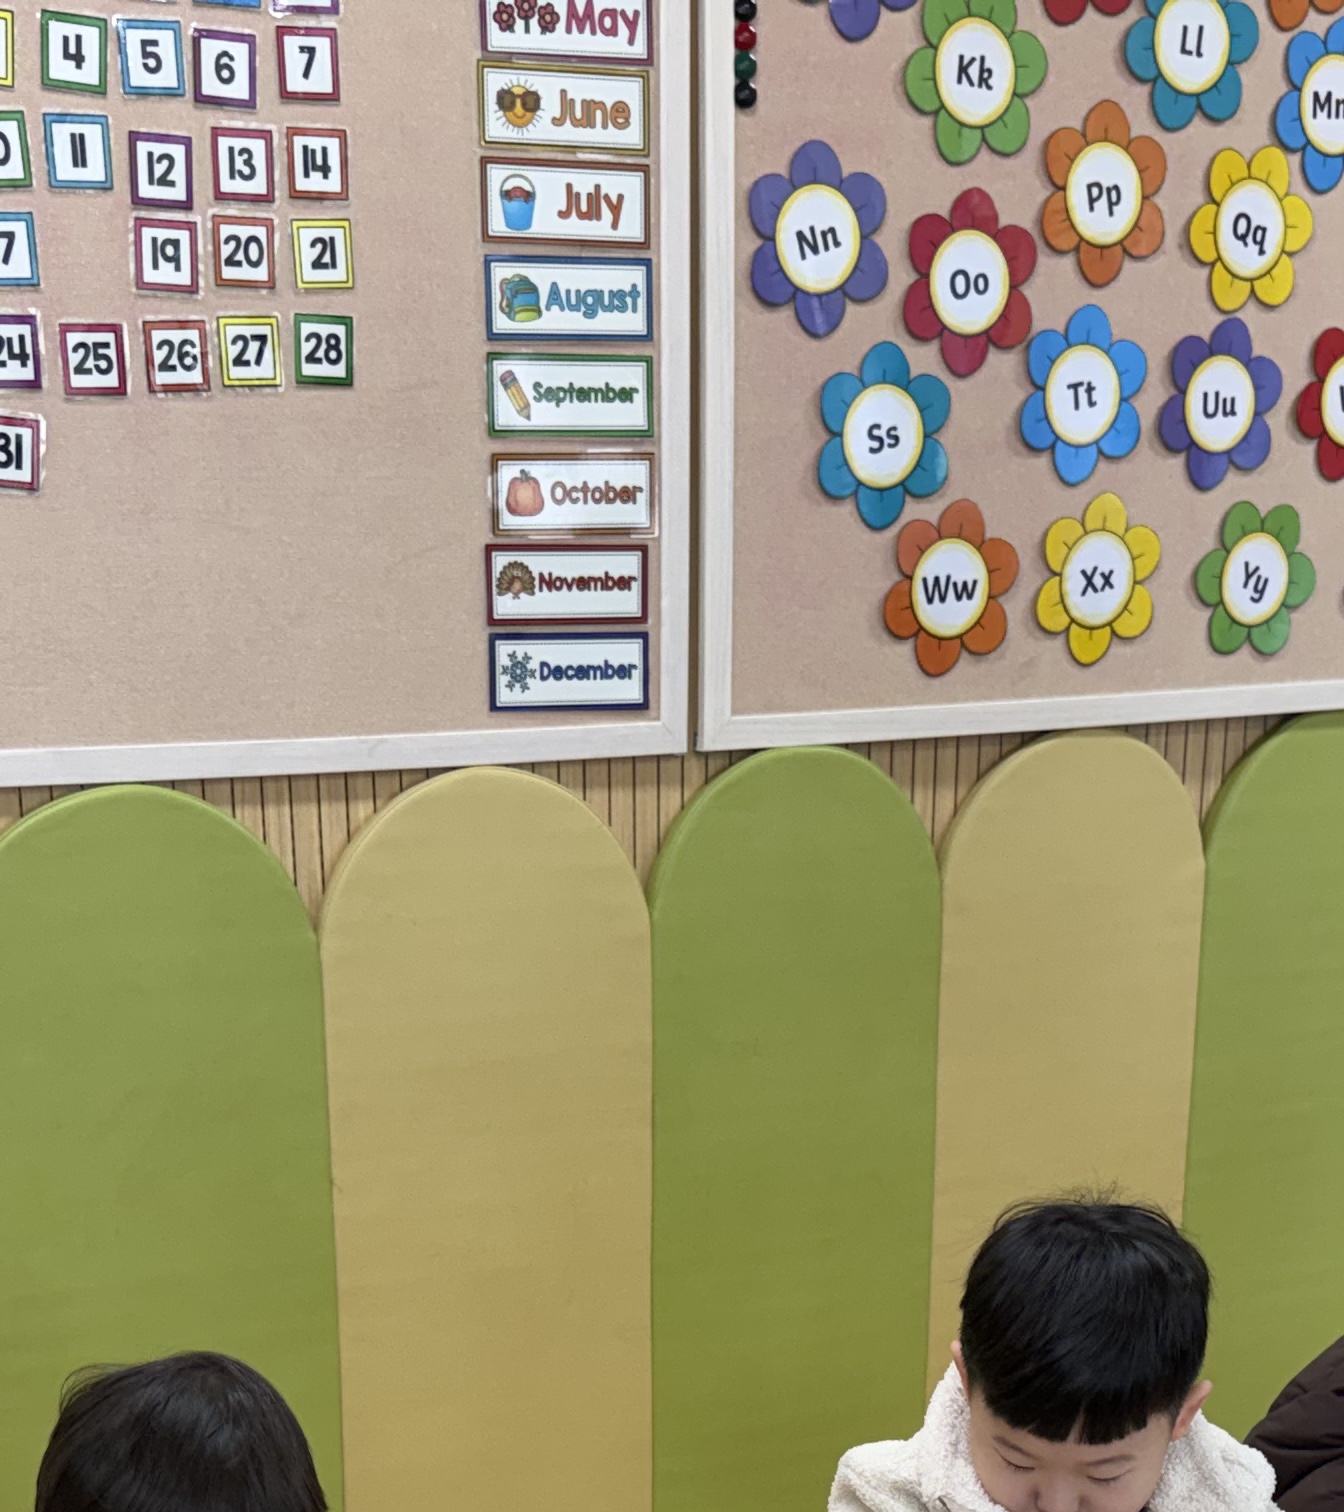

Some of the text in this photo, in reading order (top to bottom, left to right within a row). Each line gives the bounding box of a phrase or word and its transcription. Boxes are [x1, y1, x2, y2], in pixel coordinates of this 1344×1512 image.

[564, 0, 641, 47] May
[62, 33, 86, 71] 4
[139, 38, 163, 75] 5
[214, 50, 236, 86] 6
[298, 45, 317, 81] 7
[956, 54, 994, 91] Kk
[550, 88, 632, 131] June
[69, 132, 88, 169] 11
[227, 145, 257, 182] 13
[301, 144, 332, 180] 14
[146, 150, 177, 189] 12
[557, 182, 625, 231] July
[1086, 181, 1122, 218] Pp
[223, 234, 265, 269] 20
[795, 225, 842, 261] Nn
[1232, 212, 1268, 257] Qq
[151, 236, 182, 273] 19
[309, 235, 338, 271] 21
[544, 281, 641, 320] August
[949, 268, 990, 301] Oo
[71, 341, 114, 376] 25
[155, 338, 199, 373] 26
[230, 333, 269, 368] 27
[304, 331, 344, 367] 28
[532, 381, 640, 408] September
[1066, 380, 1098, 411] Tt
[1202, 390, 1238, 420] Uu
[867, 423, 901, 455] Ss
[550, 480, 644, 506] October
[538, 570, 639, 593] November
[921, 574, 978, 606] Ww
[1079, 565, 1115, 597] Xx
[1242, 560, 1269, 604] Yy
[539, 659, 639, 682] December
